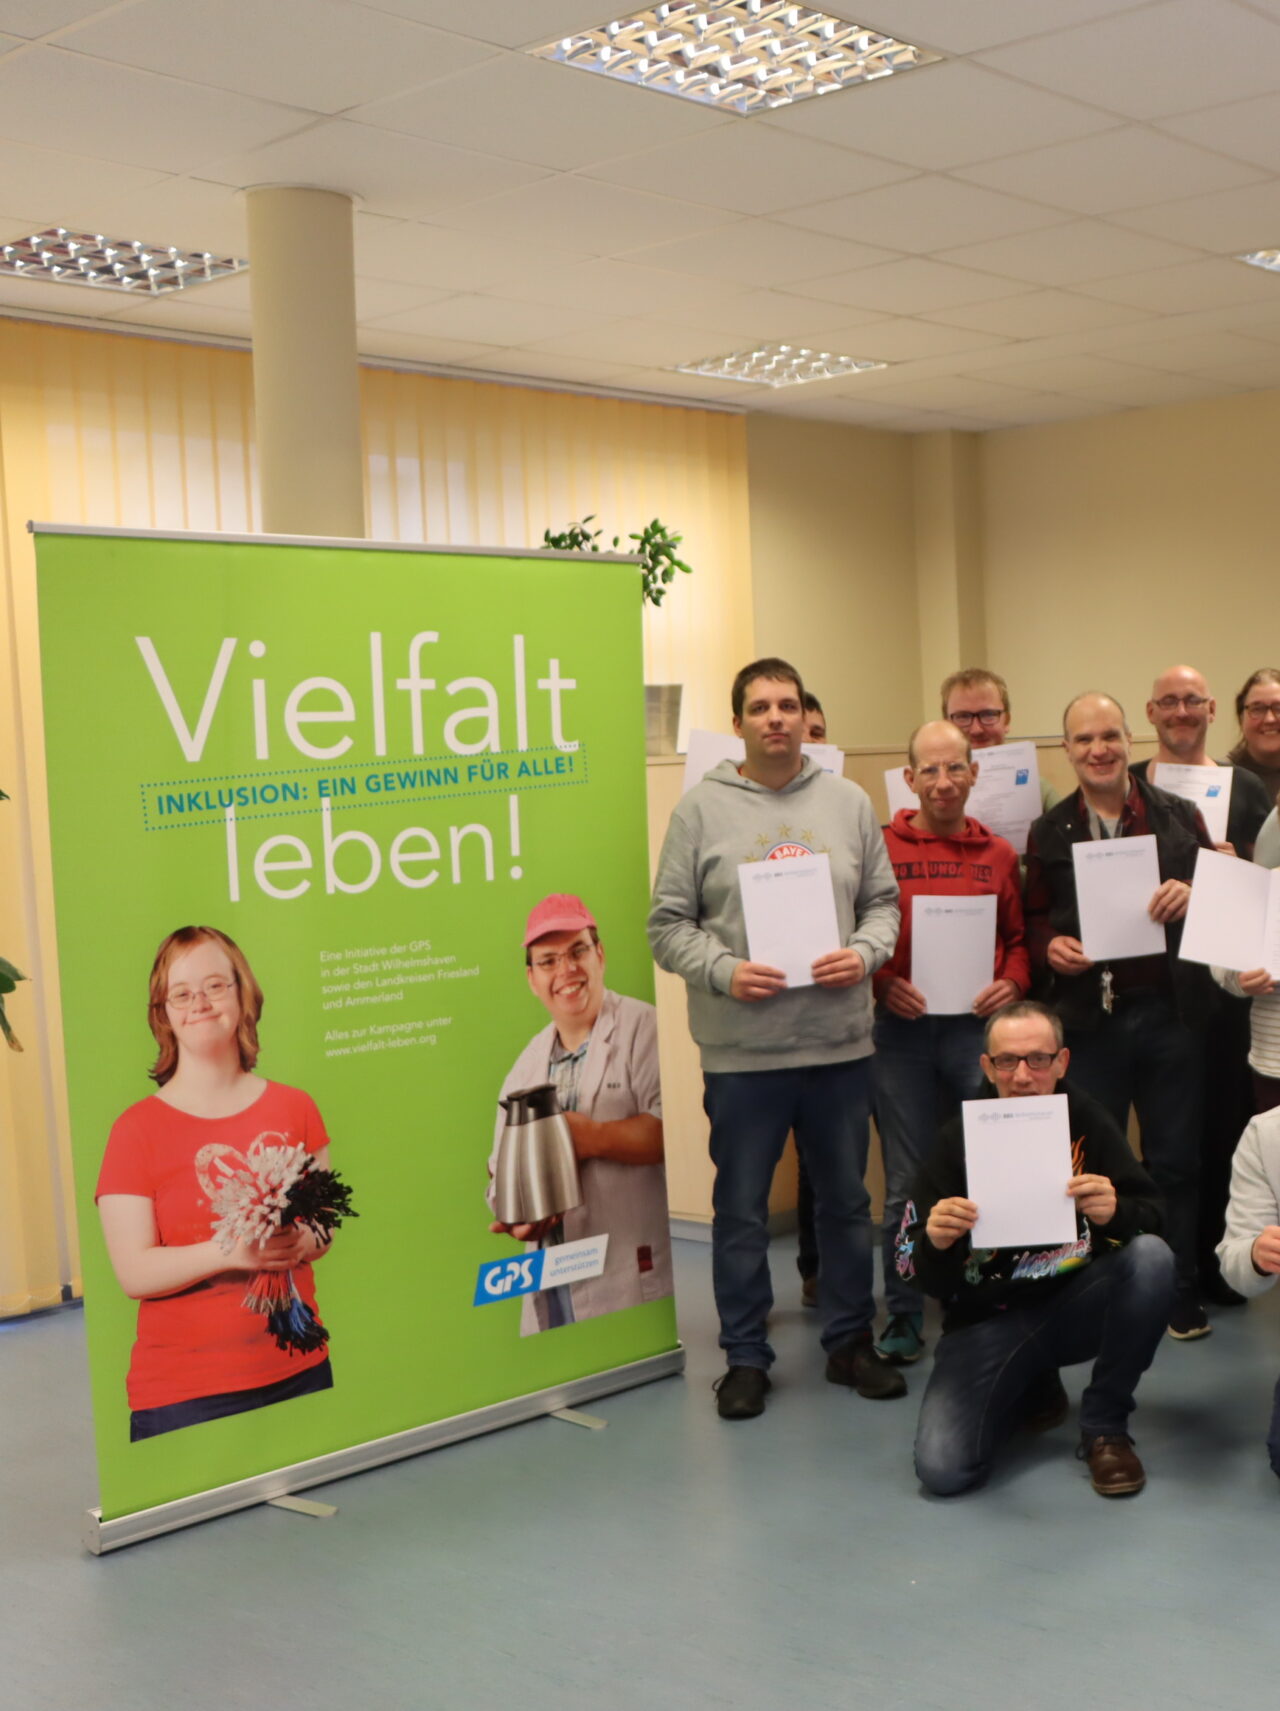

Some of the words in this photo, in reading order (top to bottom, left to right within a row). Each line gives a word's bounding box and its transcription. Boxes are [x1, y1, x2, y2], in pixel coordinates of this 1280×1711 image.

[134, 630, 580, 762] Vielfalt
[157, 781, 309, 815] INKLUSION:
[317, 775, 357, 798] EIN
[365, 761, 460, 792] GEWINN
[466, 757, 510, 783] FÜR
[517, 755, 575, 777] ALLE!
[225, 793, 524, 902] leben!
[320, 950, 343, 962] Eine
[345, 945, 388, 959] Initiative
[390, 942, 408, 954] der
[409, 939, 432, 953] GPS
[321, 967, 330, 977] in
[333, 966, 350, 977] der
[353, 961, 379, 974] Stadt
[382, 954, 457, 971] Wilhelmshaven
[322, 982, 350, 994] sowie
[353, 980, 373, 990] den
[375, 972, 435, 987] Landkreisen
[437, 965, 480, 980] Friesland
[322, 998, 343, 1010] und
[345, 990, 404, 1007] Ammerland
[325, 1029, 349, 1042] Alles
[352, 1027, 367, 1038] zur
[369, 1019, 425, 1036] Kampagne
[426, 1016, 453, 1028] unter
[325, 1033, 438, 1058] www.vielfalt-leben.org
[484, 1257, 534, 1295] GPS
